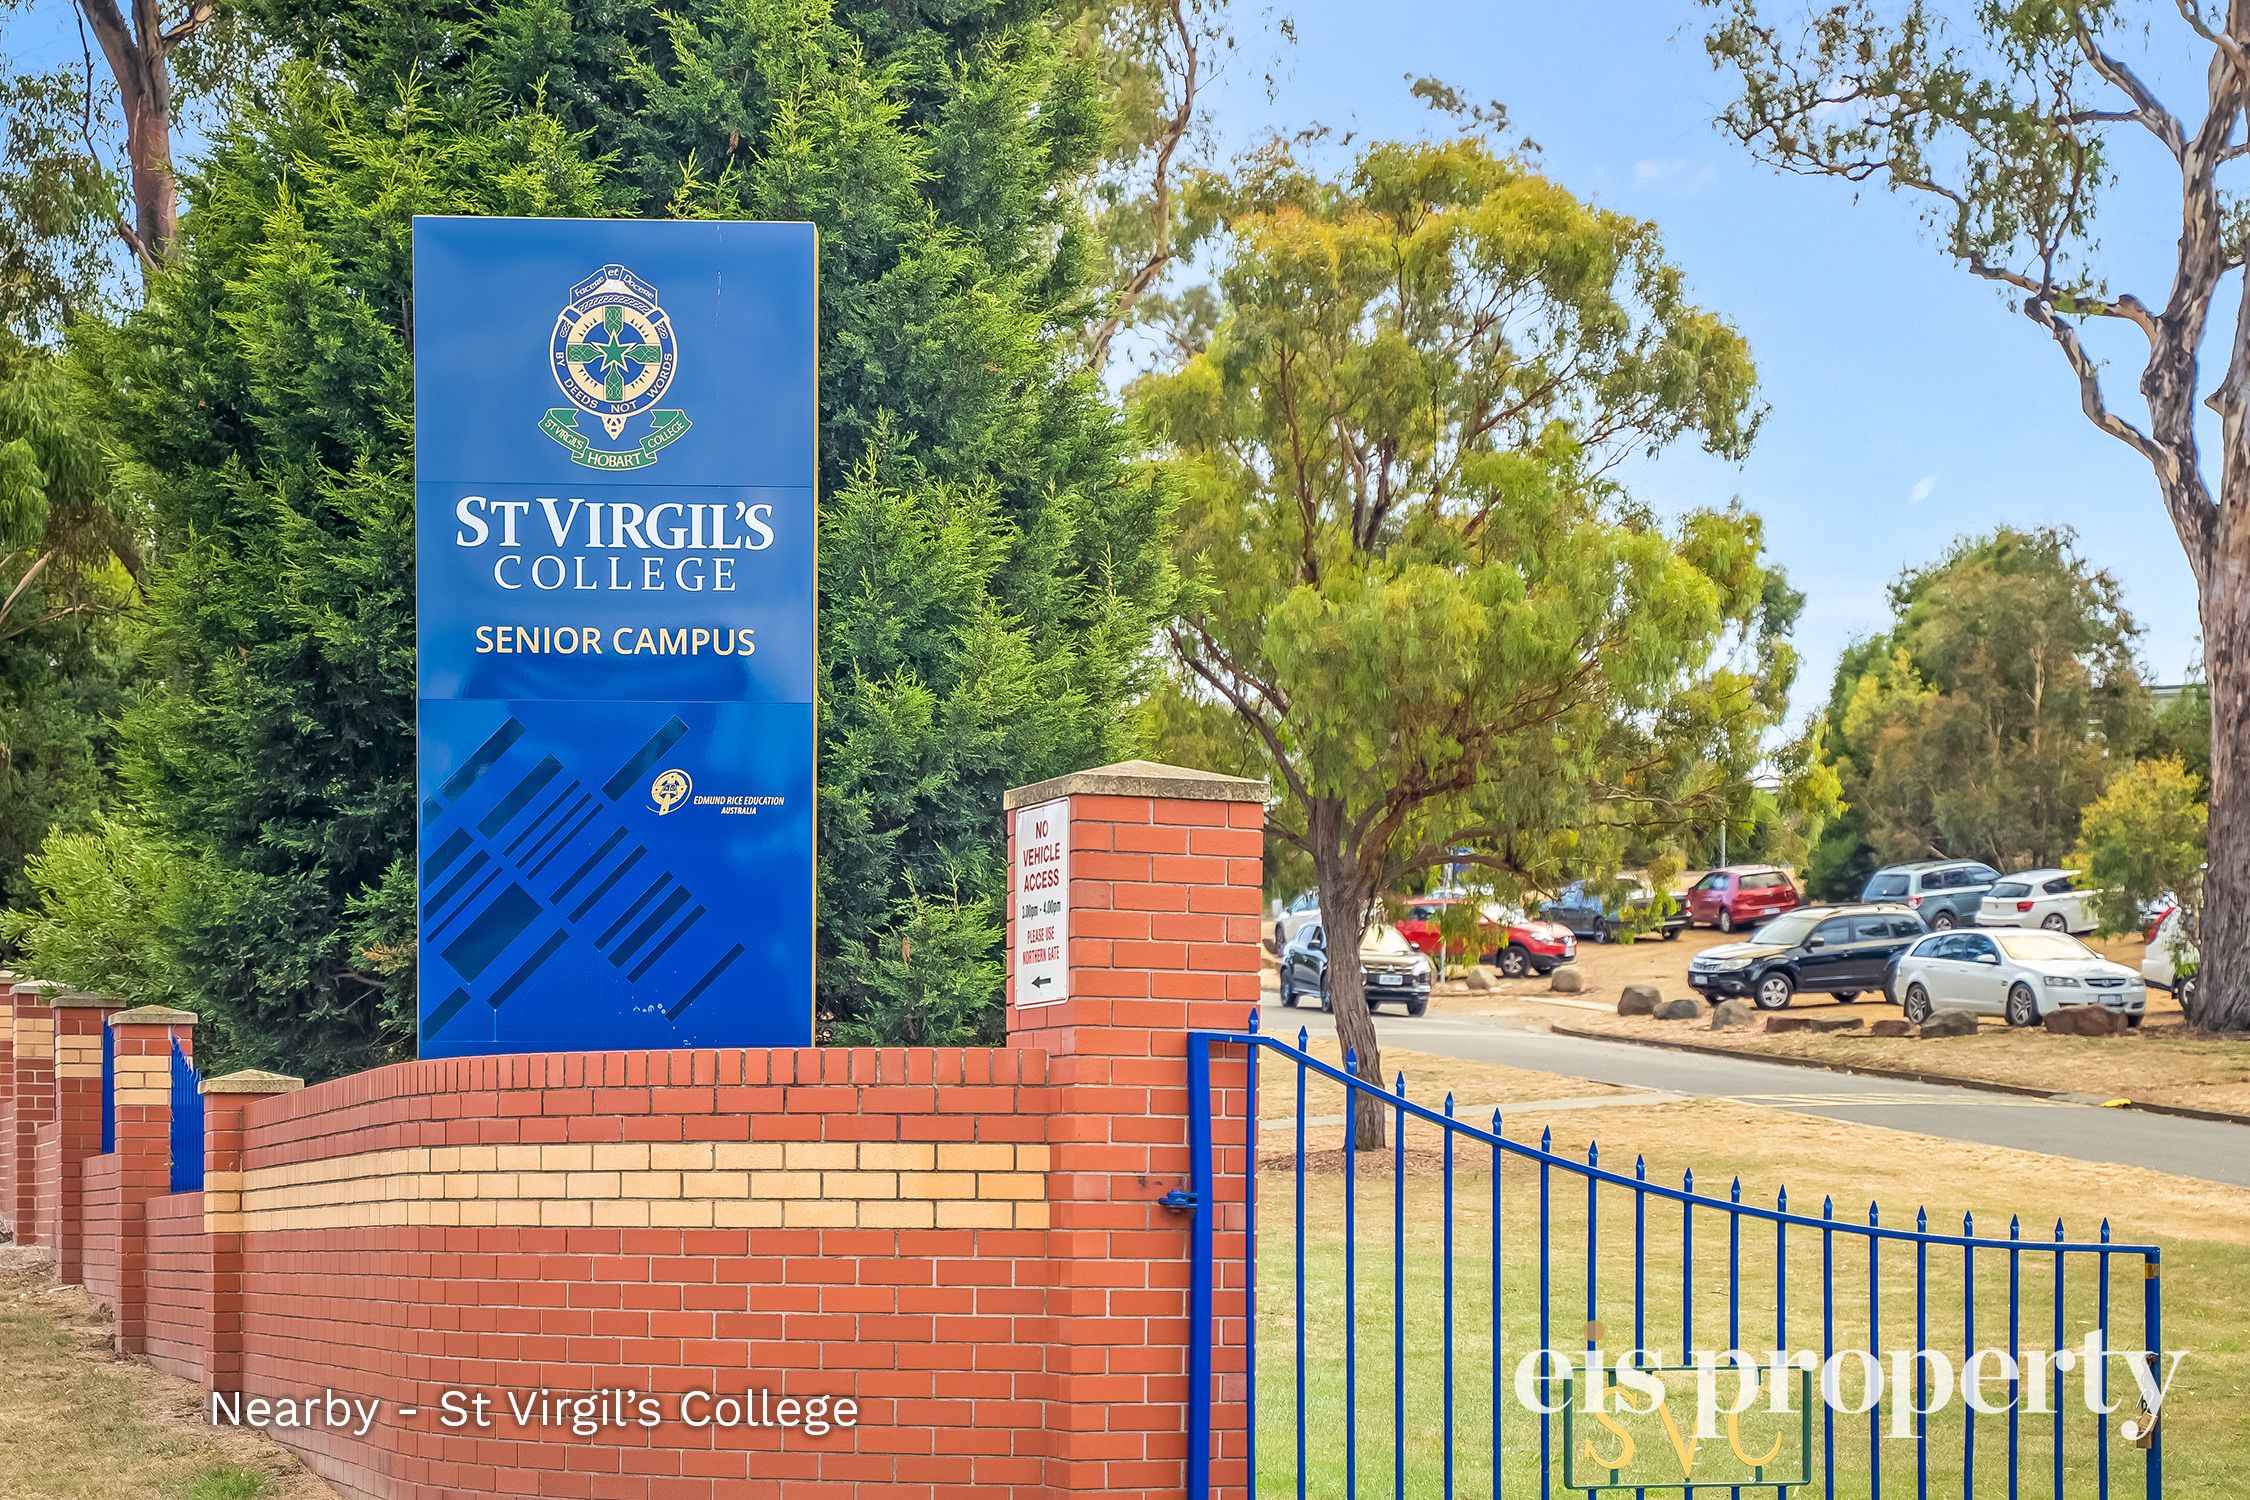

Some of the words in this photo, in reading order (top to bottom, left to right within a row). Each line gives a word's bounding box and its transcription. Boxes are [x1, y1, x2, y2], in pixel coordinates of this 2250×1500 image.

[555, 352, 566, 367] BY
[564, 378, 598, 409] DEEDS
[610, 400, 638, 413] NOT
[646, 353, 673, 399] WORDS
[647, 420, 685, 449] COLLEGE
[587, 452, 642, 468] HOBART
[455, 496, 530, 548] ST
[535, 497, 775, 551] VIRGIL'S
[493, 555, 736, 592] COLLEGE
[475, 625, 603, 655] SENIOR
[612, 627, 756, 657] CAMPUS
[693, 795, 726, 805] EDMUND
[726, 796, 744, 805] RICE
[744, 796, 785, 806] EDUCATION
[720, 807, 757, 815] AUSTRALIA
[1035, 819, 1049, 840] NO
[1022, 842, 1060, 868] VEHICLE
[1023, 868, 1060, 893] ACCESS
[1027, 927, 1044, 944] PLEASE
[1045, 925, 1055, 941] USE
[1022, 948, 1047, 965] NORTHERN
[1047, 945, 1060, 961] GATE
